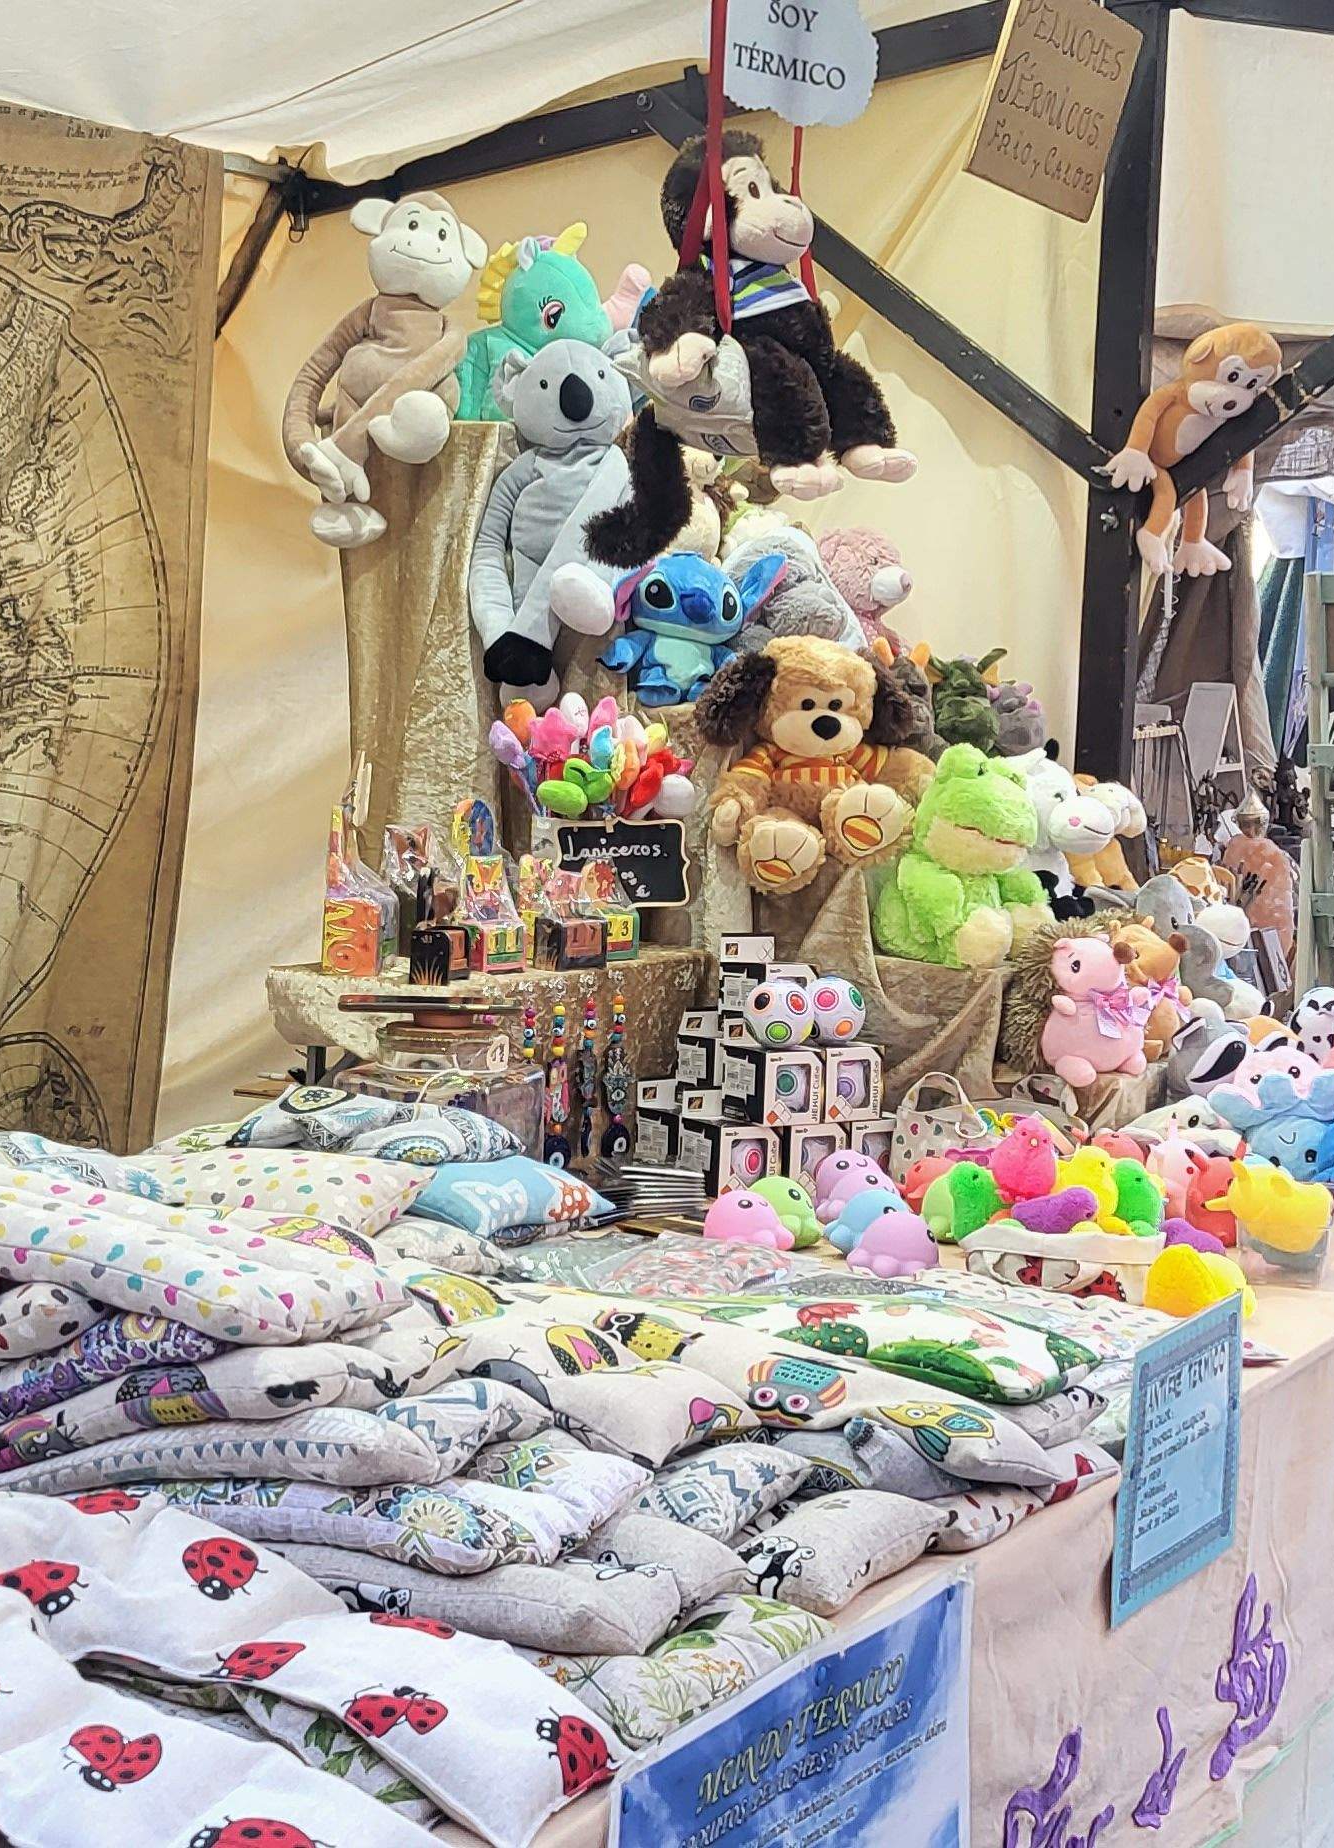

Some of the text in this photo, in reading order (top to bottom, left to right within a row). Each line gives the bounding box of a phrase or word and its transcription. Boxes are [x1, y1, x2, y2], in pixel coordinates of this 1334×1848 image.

[768, 0, 819, 33] SOY
[1017, 0, 1126, 82] PELUCHES
[733, 42, 846, 90] TÉRMICO
[1043, 145, 1093, 194] CALOR
[696, 1717, 794, 1815] MUNDO
[796, 1652, 905, 1747] TÉRMICO
